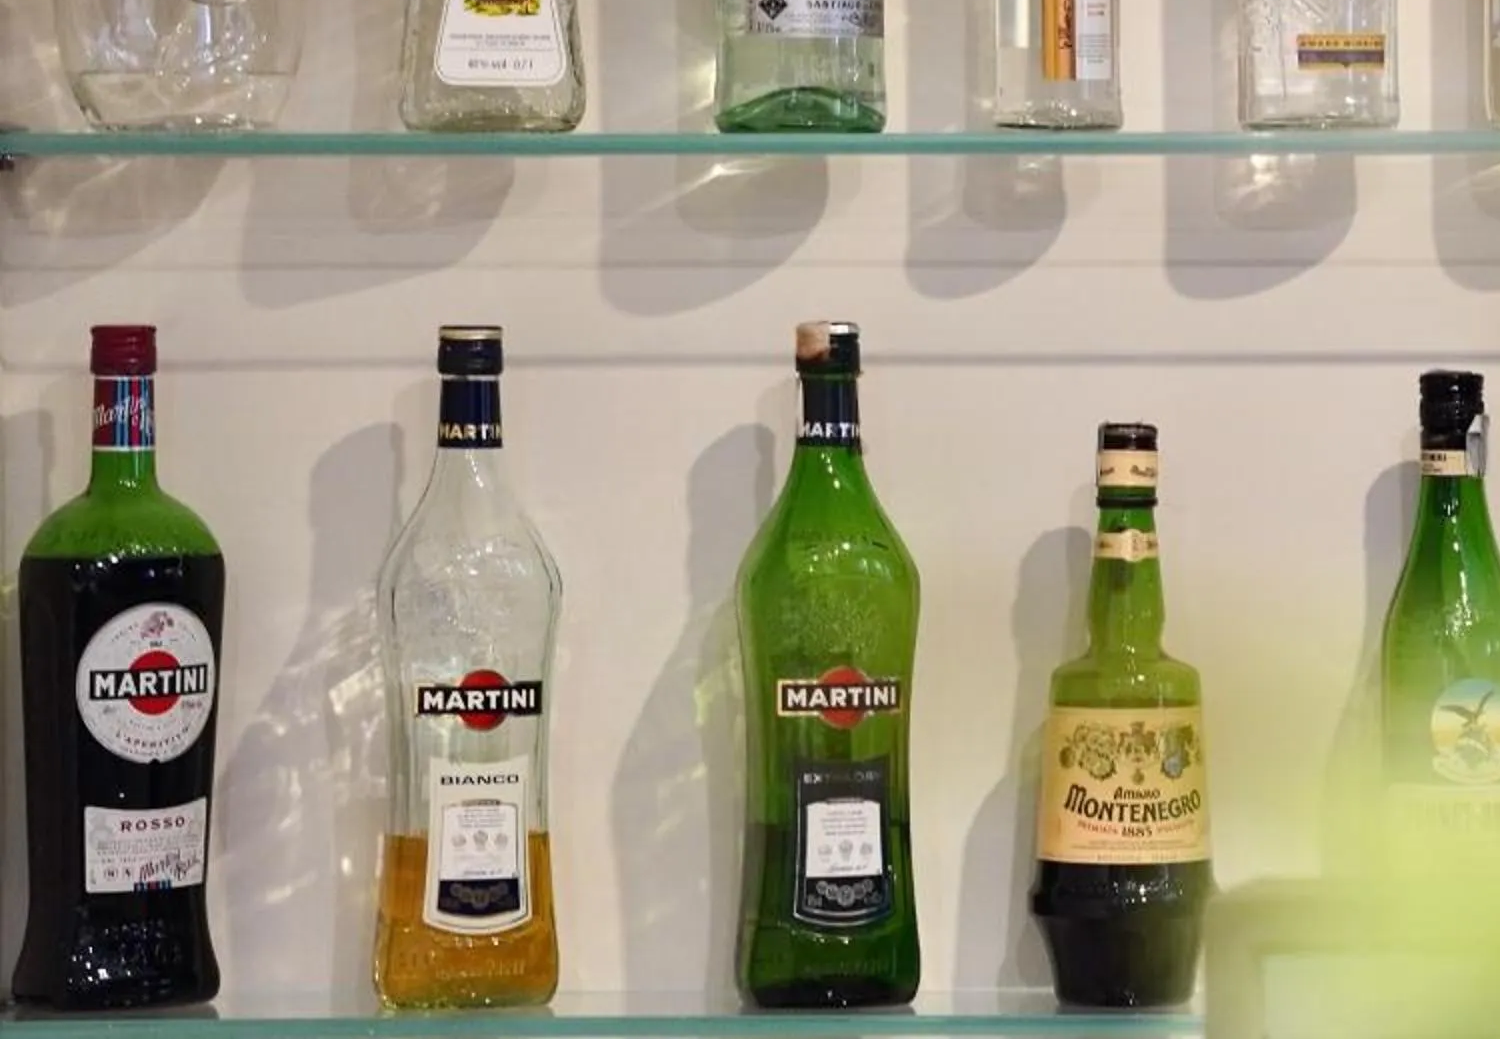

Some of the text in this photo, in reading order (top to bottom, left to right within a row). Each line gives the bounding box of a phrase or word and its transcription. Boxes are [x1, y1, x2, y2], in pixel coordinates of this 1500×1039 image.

[94, 667, 205, 698] MARTINI
[423, 688, 535, 711] MARTINI
[787, 686, 896, 708] MARTINI
[441, 773, 519, 786] BIANCO
[120, 816, 186, 833] ROSSO
